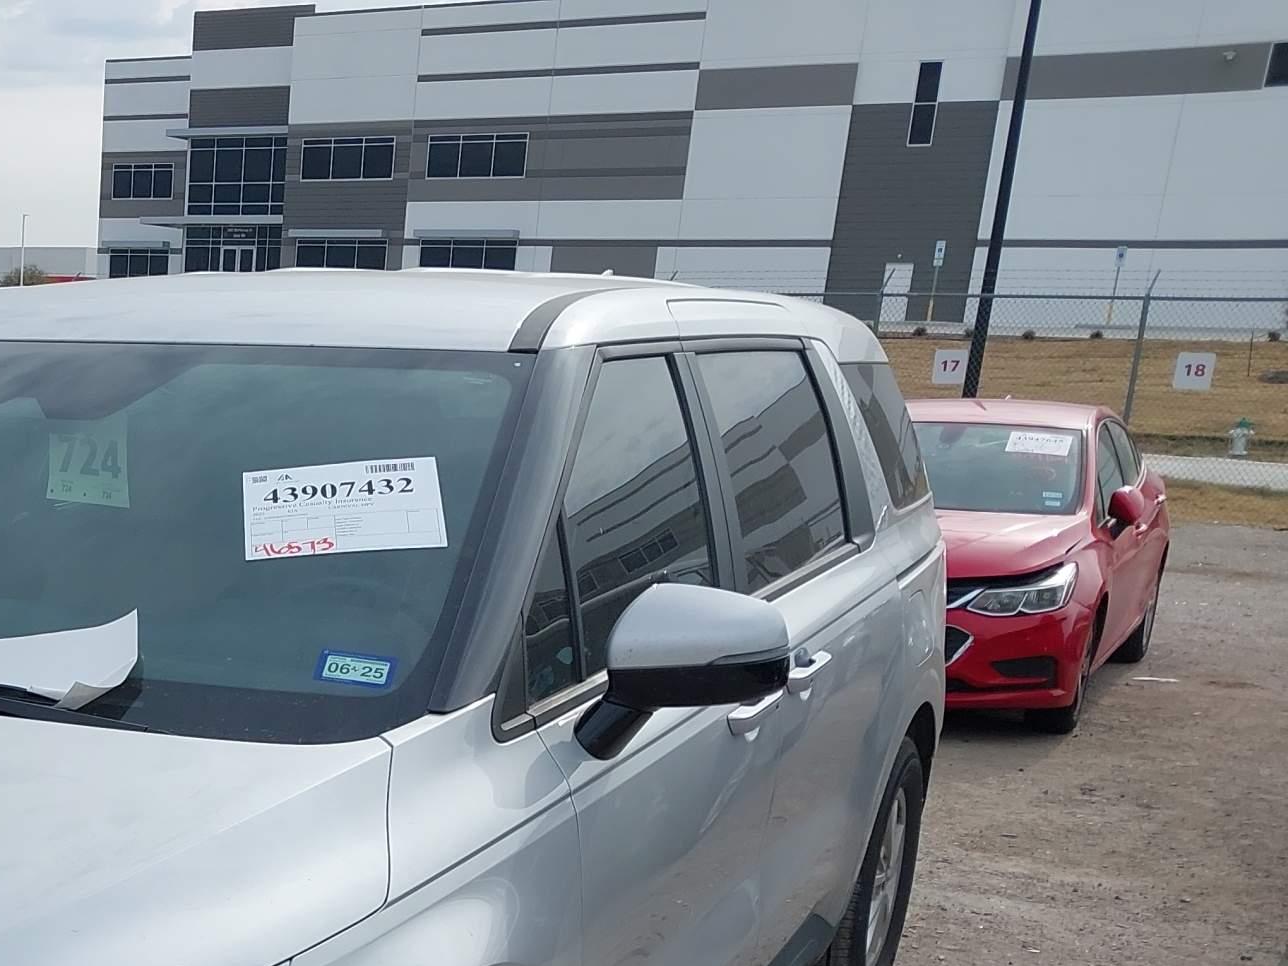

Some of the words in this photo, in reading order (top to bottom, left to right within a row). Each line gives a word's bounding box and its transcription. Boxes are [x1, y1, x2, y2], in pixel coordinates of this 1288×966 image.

[941, 360, 961, 372] 17
[1185, 363, 1206, 377] 18
[57, 433, 122, 479] 724
[263, 477, 414, 504] 43907432
[327, 662, 352, 675] 06
[359, 665, 385, 679] 25
